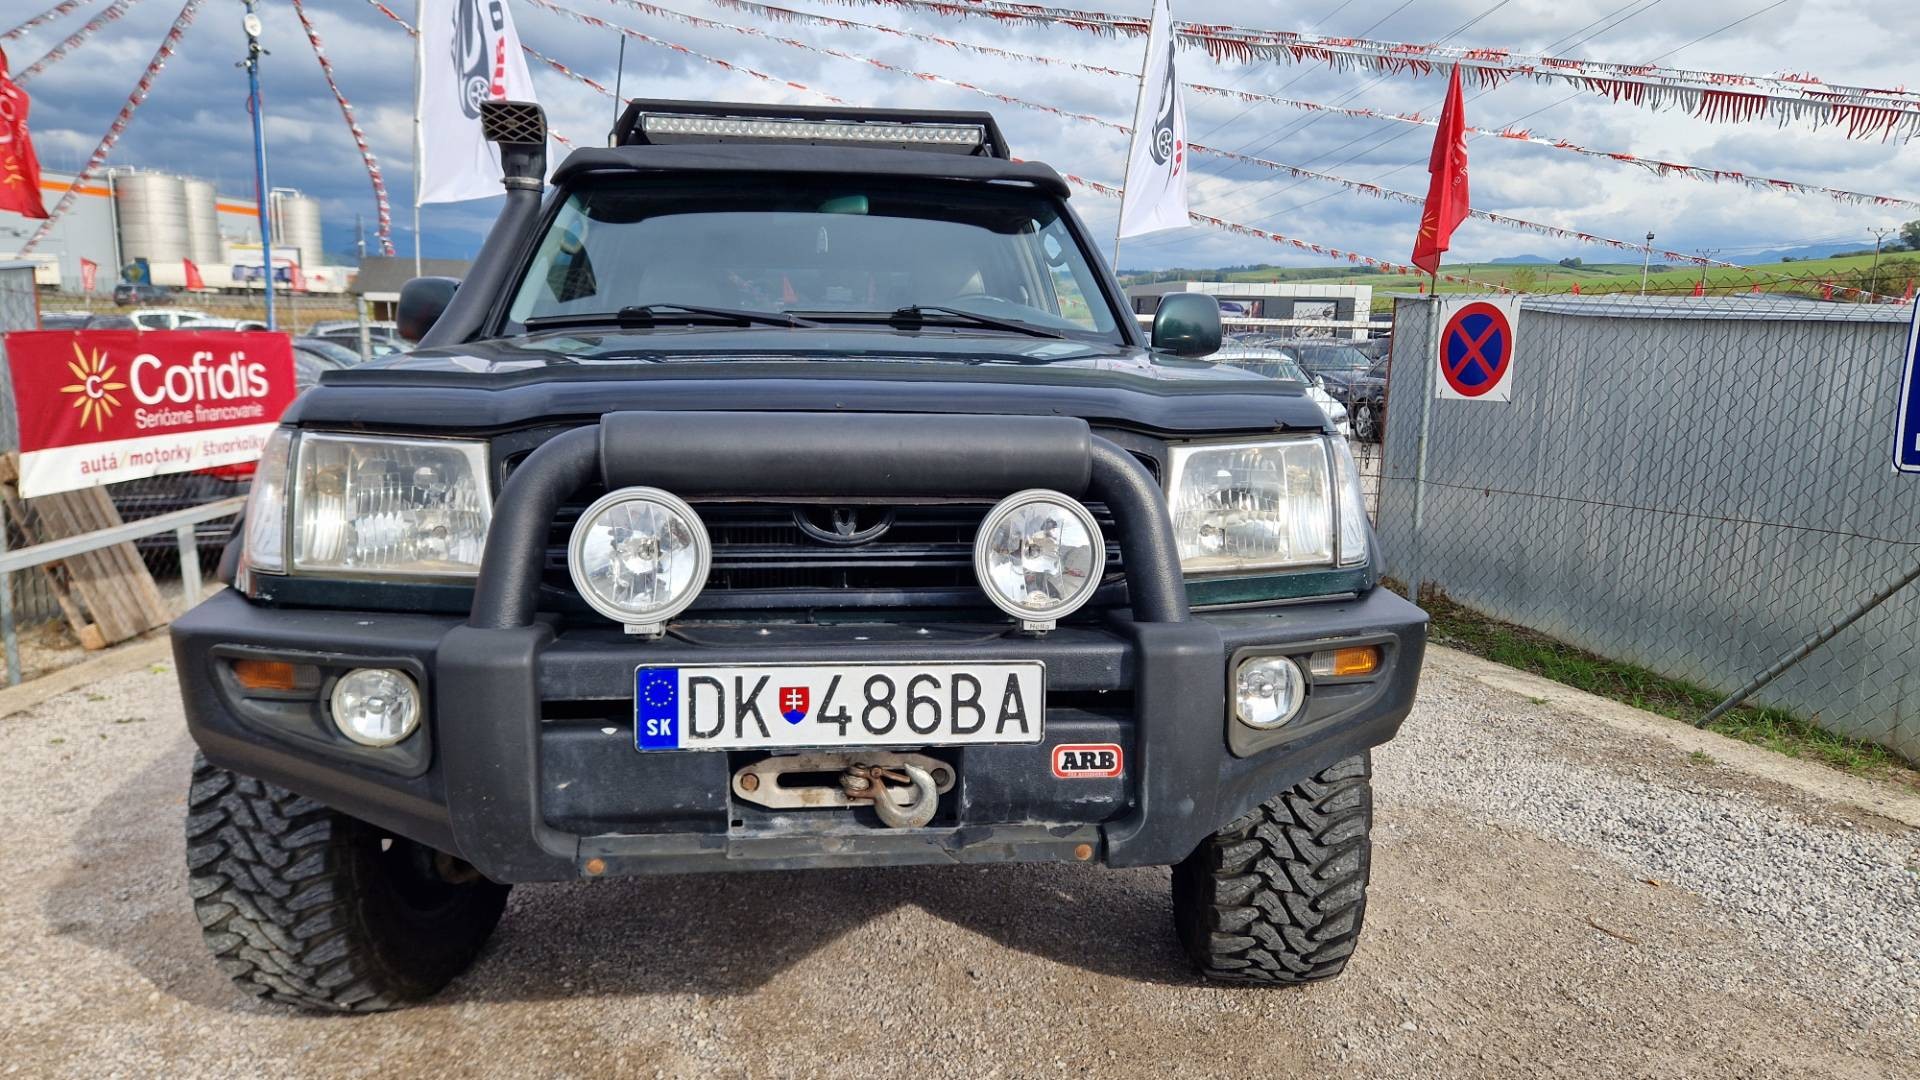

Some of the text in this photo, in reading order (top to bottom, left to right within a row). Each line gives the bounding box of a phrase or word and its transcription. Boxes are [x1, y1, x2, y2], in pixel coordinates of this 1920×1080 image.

[129, 351, 269, 405] Cofidis
[134, 407, 194, 429] Seriózne
[81, 452, 118, 474] autá
[130, 444, 192, 467] motorky
[687, 673, 1030, 739] DK 486BA
[646, 718, 672, 737] SK
[1061, 751, 1115, 770] ARB
